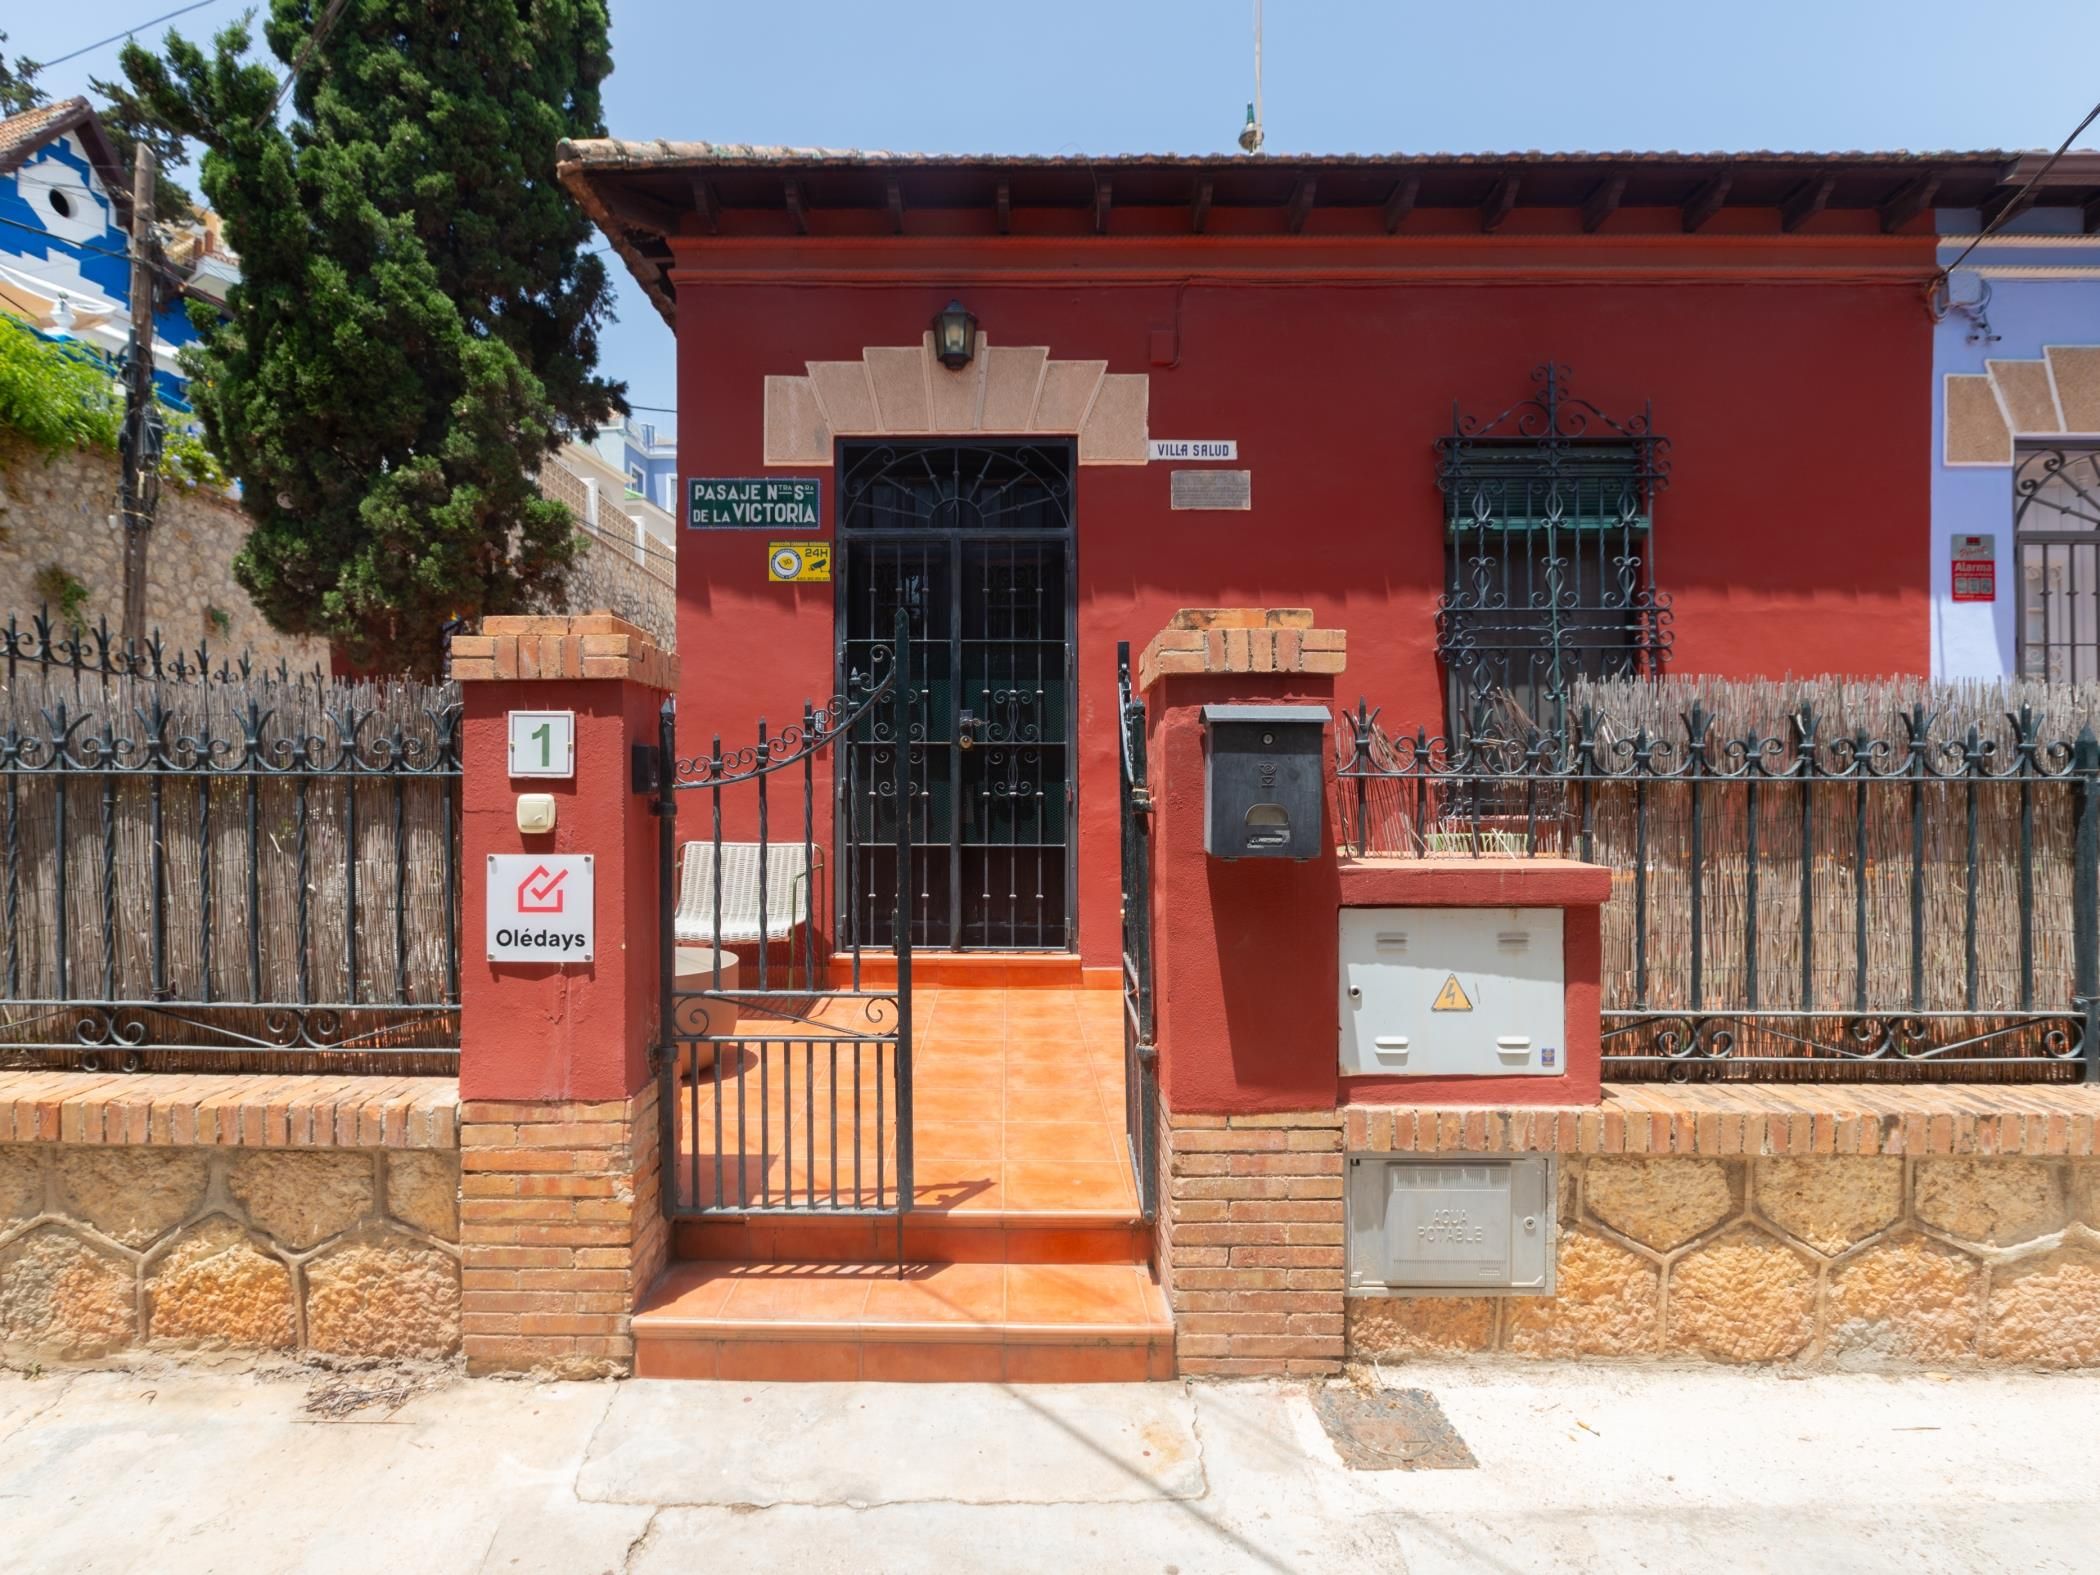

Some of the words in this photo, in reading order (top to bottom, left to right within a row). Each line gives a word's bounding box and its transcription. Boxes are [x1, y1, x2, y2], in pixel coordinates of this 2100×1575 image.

[1157, 443, 1188, 457] VILLA
[1192, 444, 1229, 457] SALUD
[694, 484, 761, 500] PASAJE
[693, 509, 709, 522] DE
[713, 510, 731, 522] LA
[732, 503, 817, 523] VICTORIA
[805, 548, 828, 558] 24H
[531, 723, 551, 767] 1
[496, 928, 586, 951] Olédays
[1417, 1226, 1483, 1243] POTABLE
